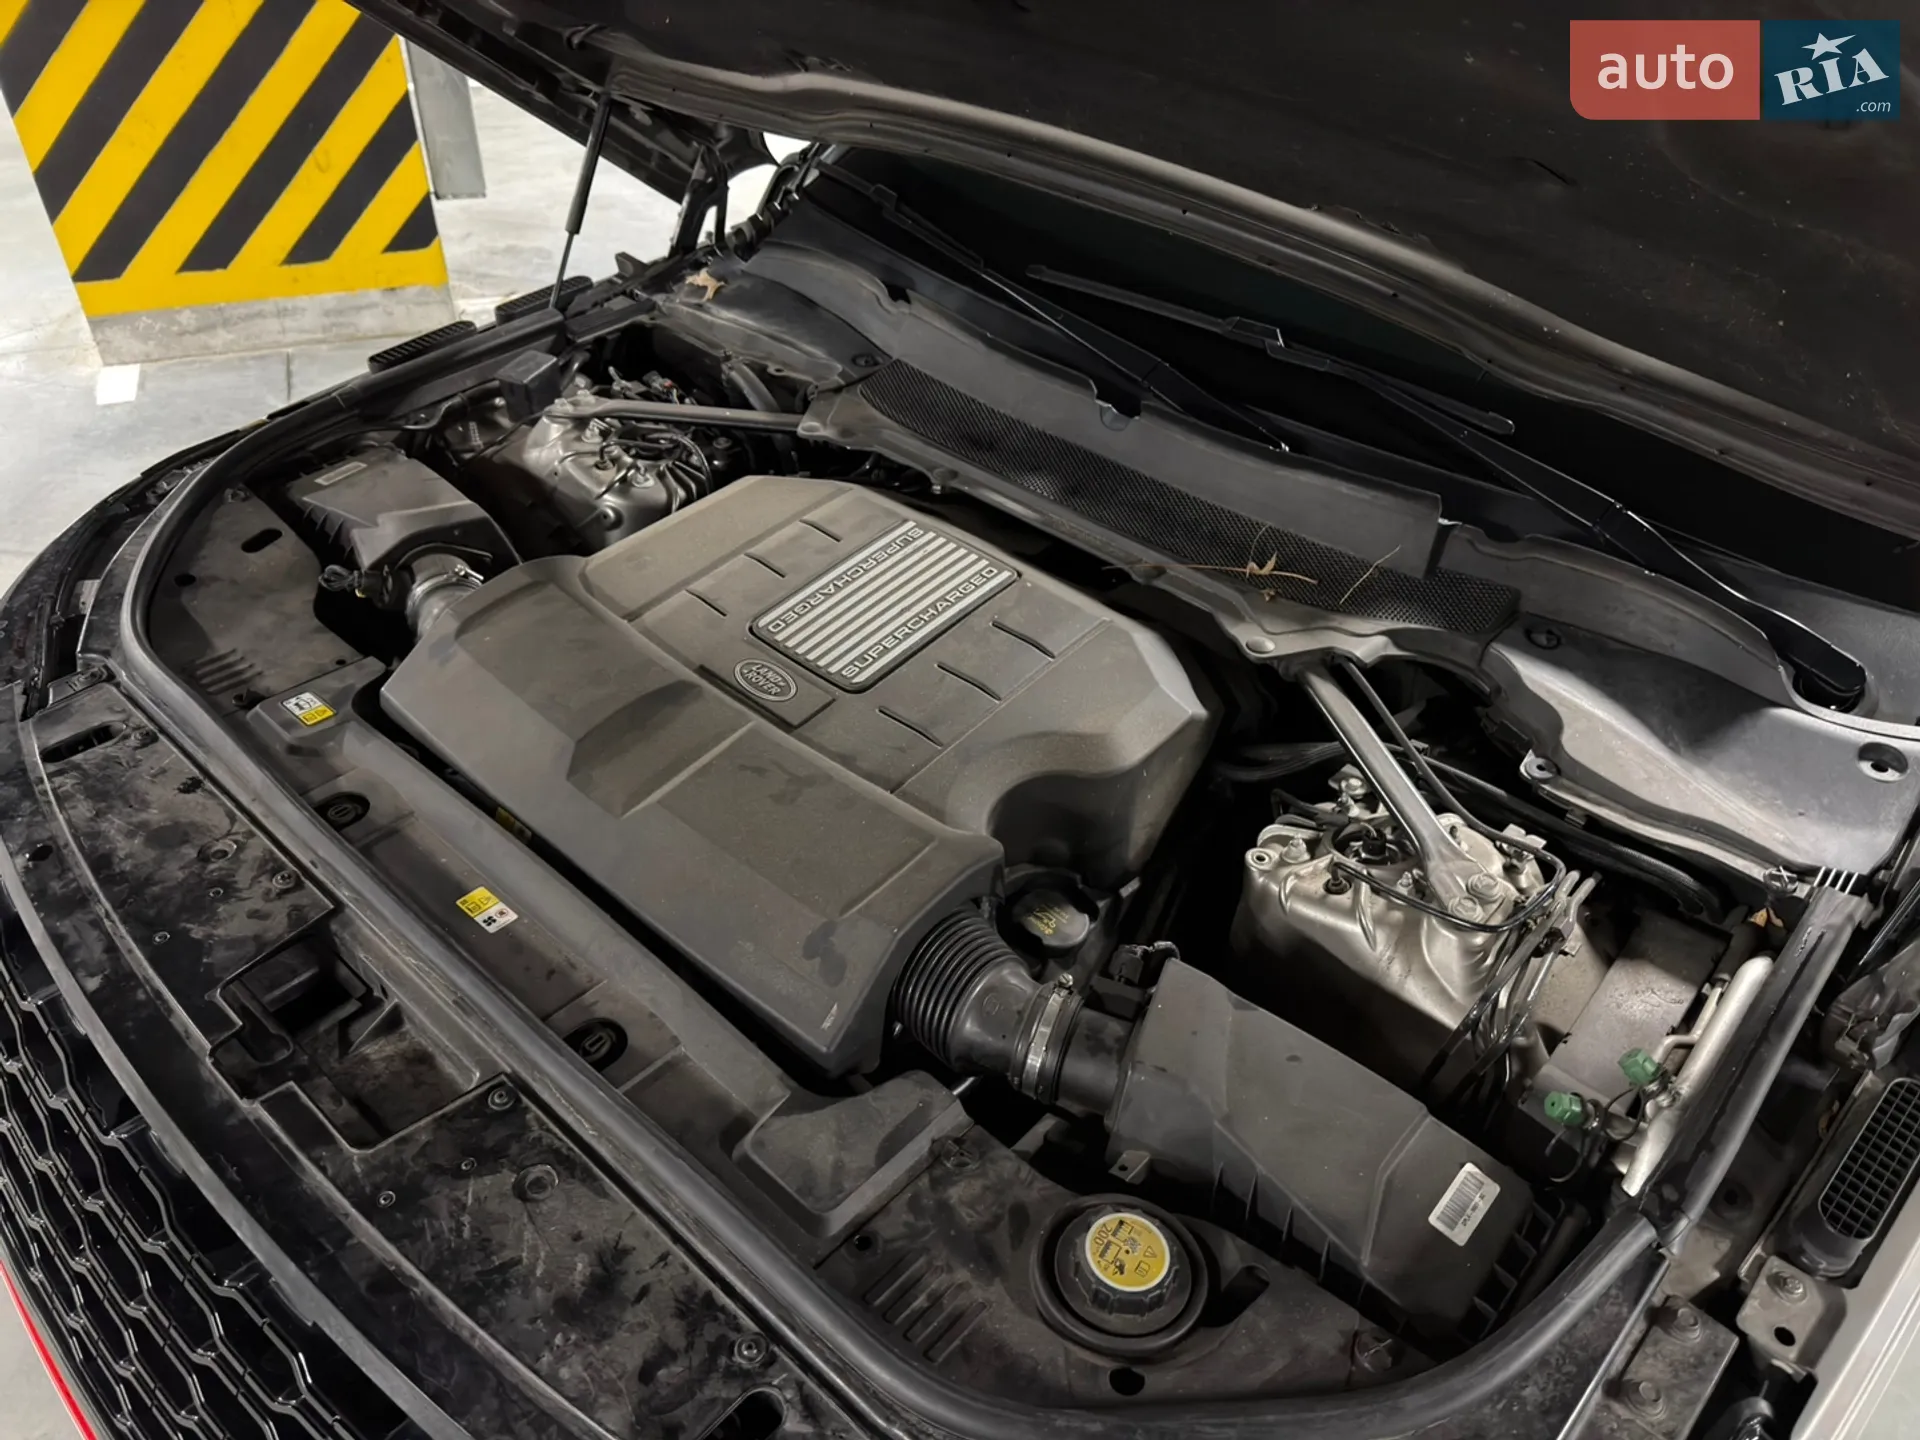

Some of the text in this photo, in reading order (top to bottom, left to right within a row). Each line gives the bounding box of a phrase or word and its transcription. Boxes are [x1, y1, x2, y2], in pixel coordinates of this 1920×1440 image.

[768, 527, 924, 633] SUPERCHARGED
[841, 566, 998, 678] SUPERCHARGED
[746, 670, 781, 695] ROVER
[751, 664, 782, 682] LAND
